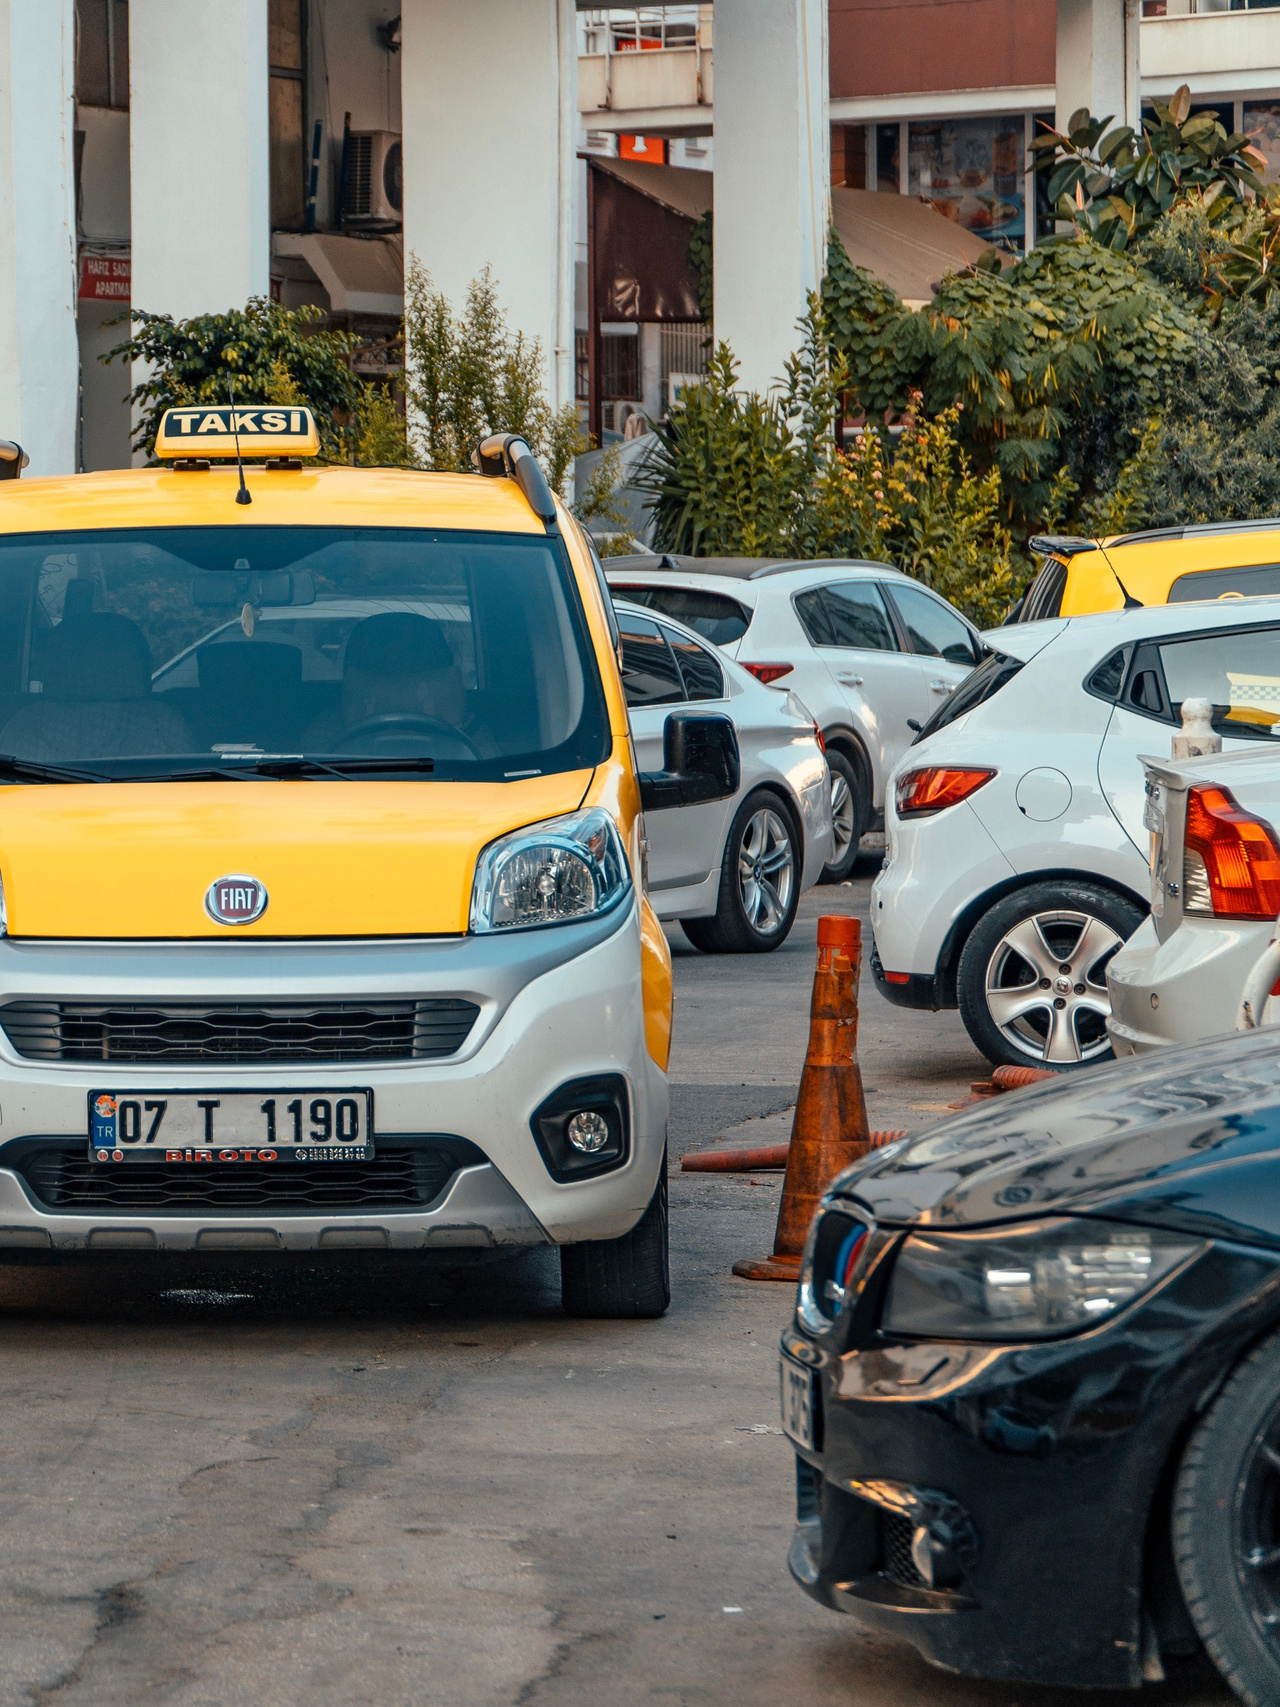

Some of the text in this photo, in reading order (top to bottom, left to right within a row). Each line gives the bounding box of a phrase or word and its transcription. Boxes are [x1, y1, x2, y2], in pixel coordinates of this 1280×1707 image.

[172, 410, 302, 433] TAKSİ
[221, 888, 255, 910] FIAT
[119, 1098, 360, 1143] 07 T 1190
[96, 1126, 114, 1138] TR
[219, 1149, 278, 1162] OTO
